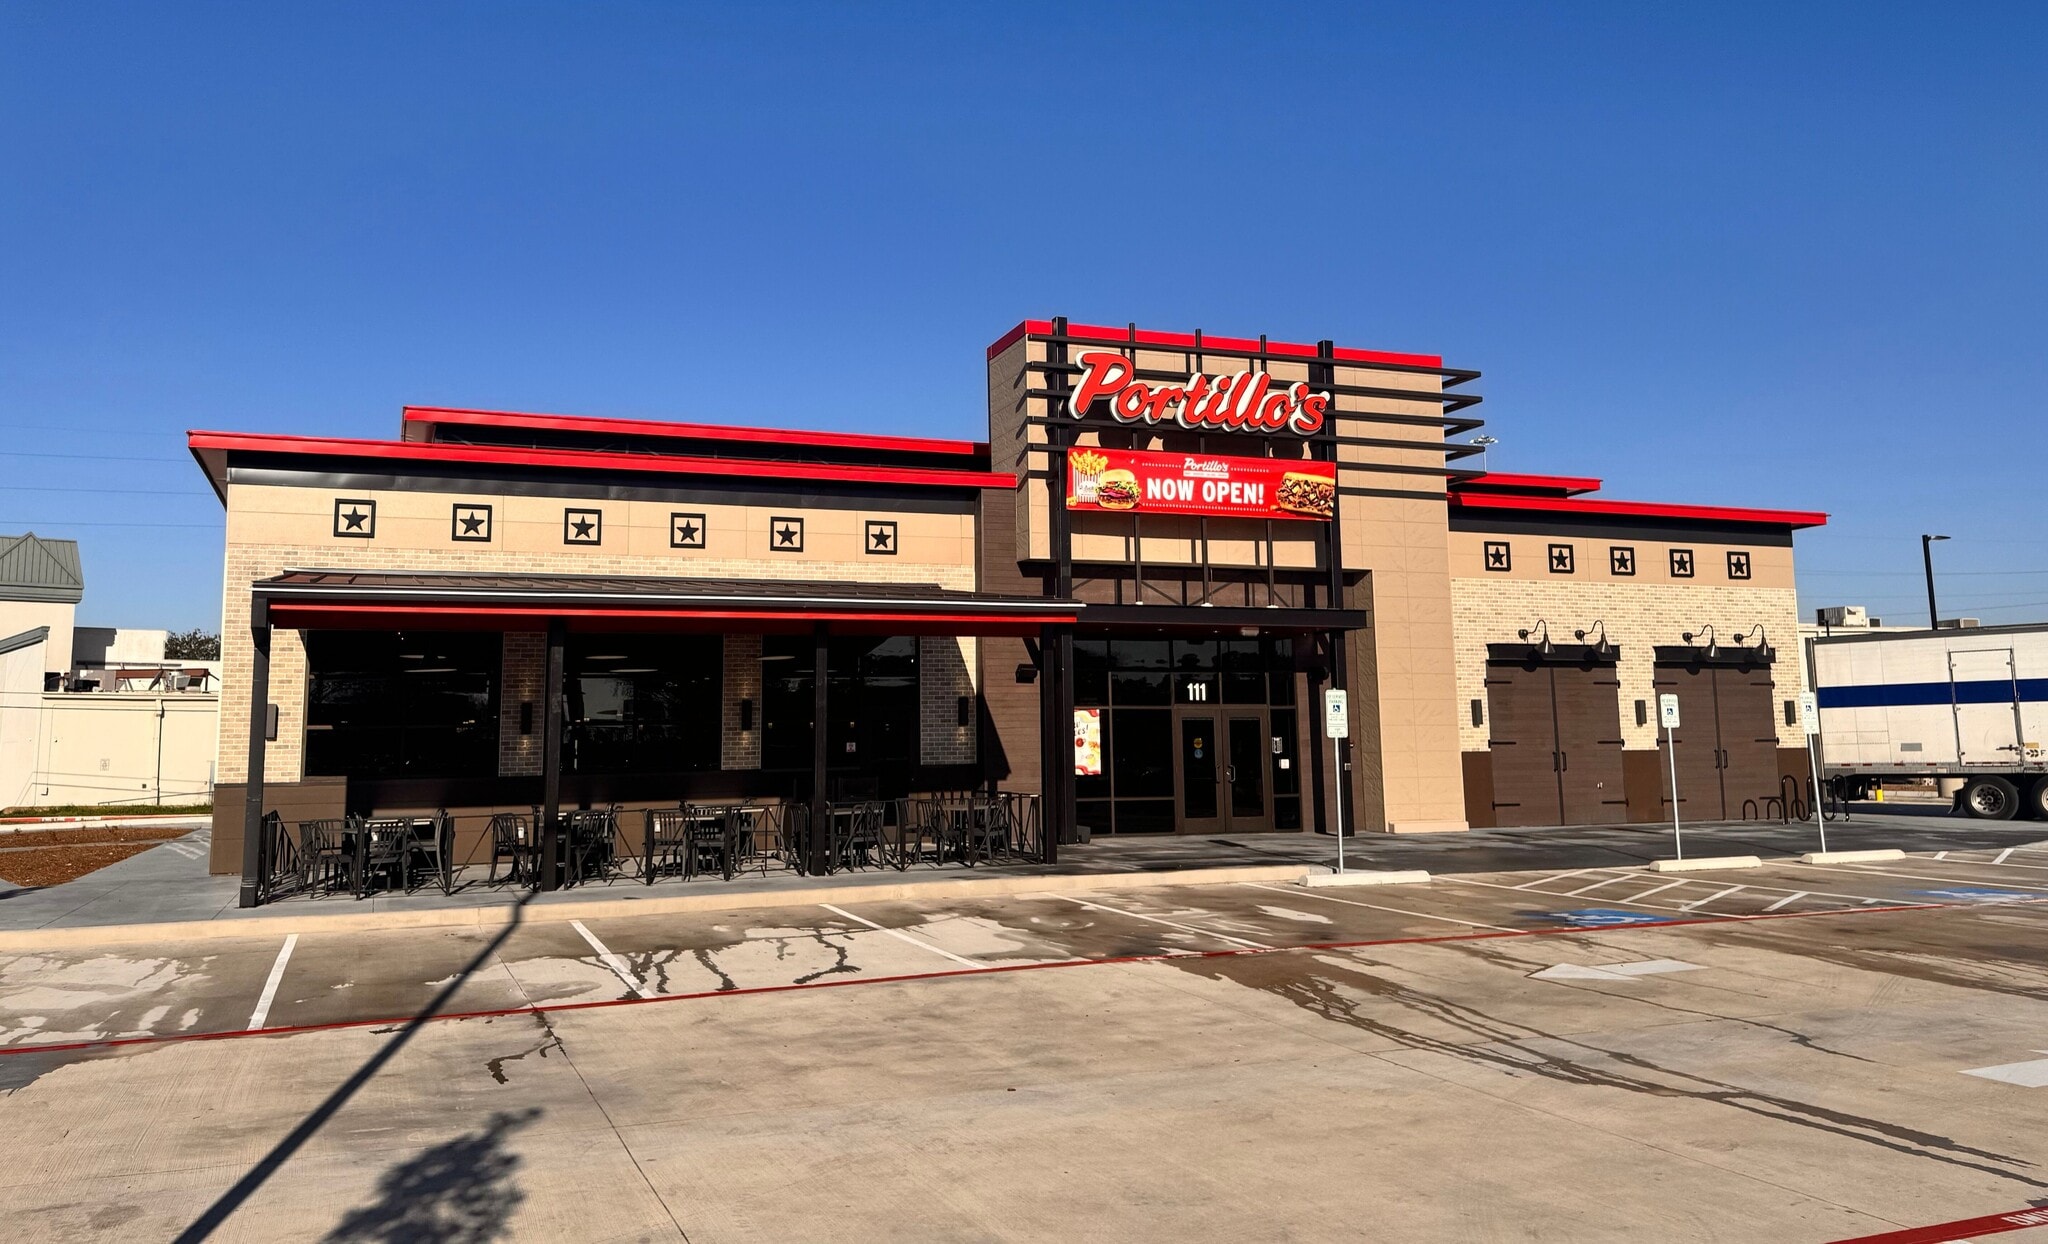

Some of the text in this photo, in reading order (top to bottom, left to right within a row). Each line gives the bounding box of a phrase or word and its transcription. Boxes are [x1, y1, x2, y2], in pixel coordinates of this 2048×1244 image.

[1068, 350, 1330, 435] Portillo's
[1184, 457, 1229, 472] Portillo's
[1147, 478, 1264, 505] NOW OPEN!
[1187, 683, 1206, 701] 111
